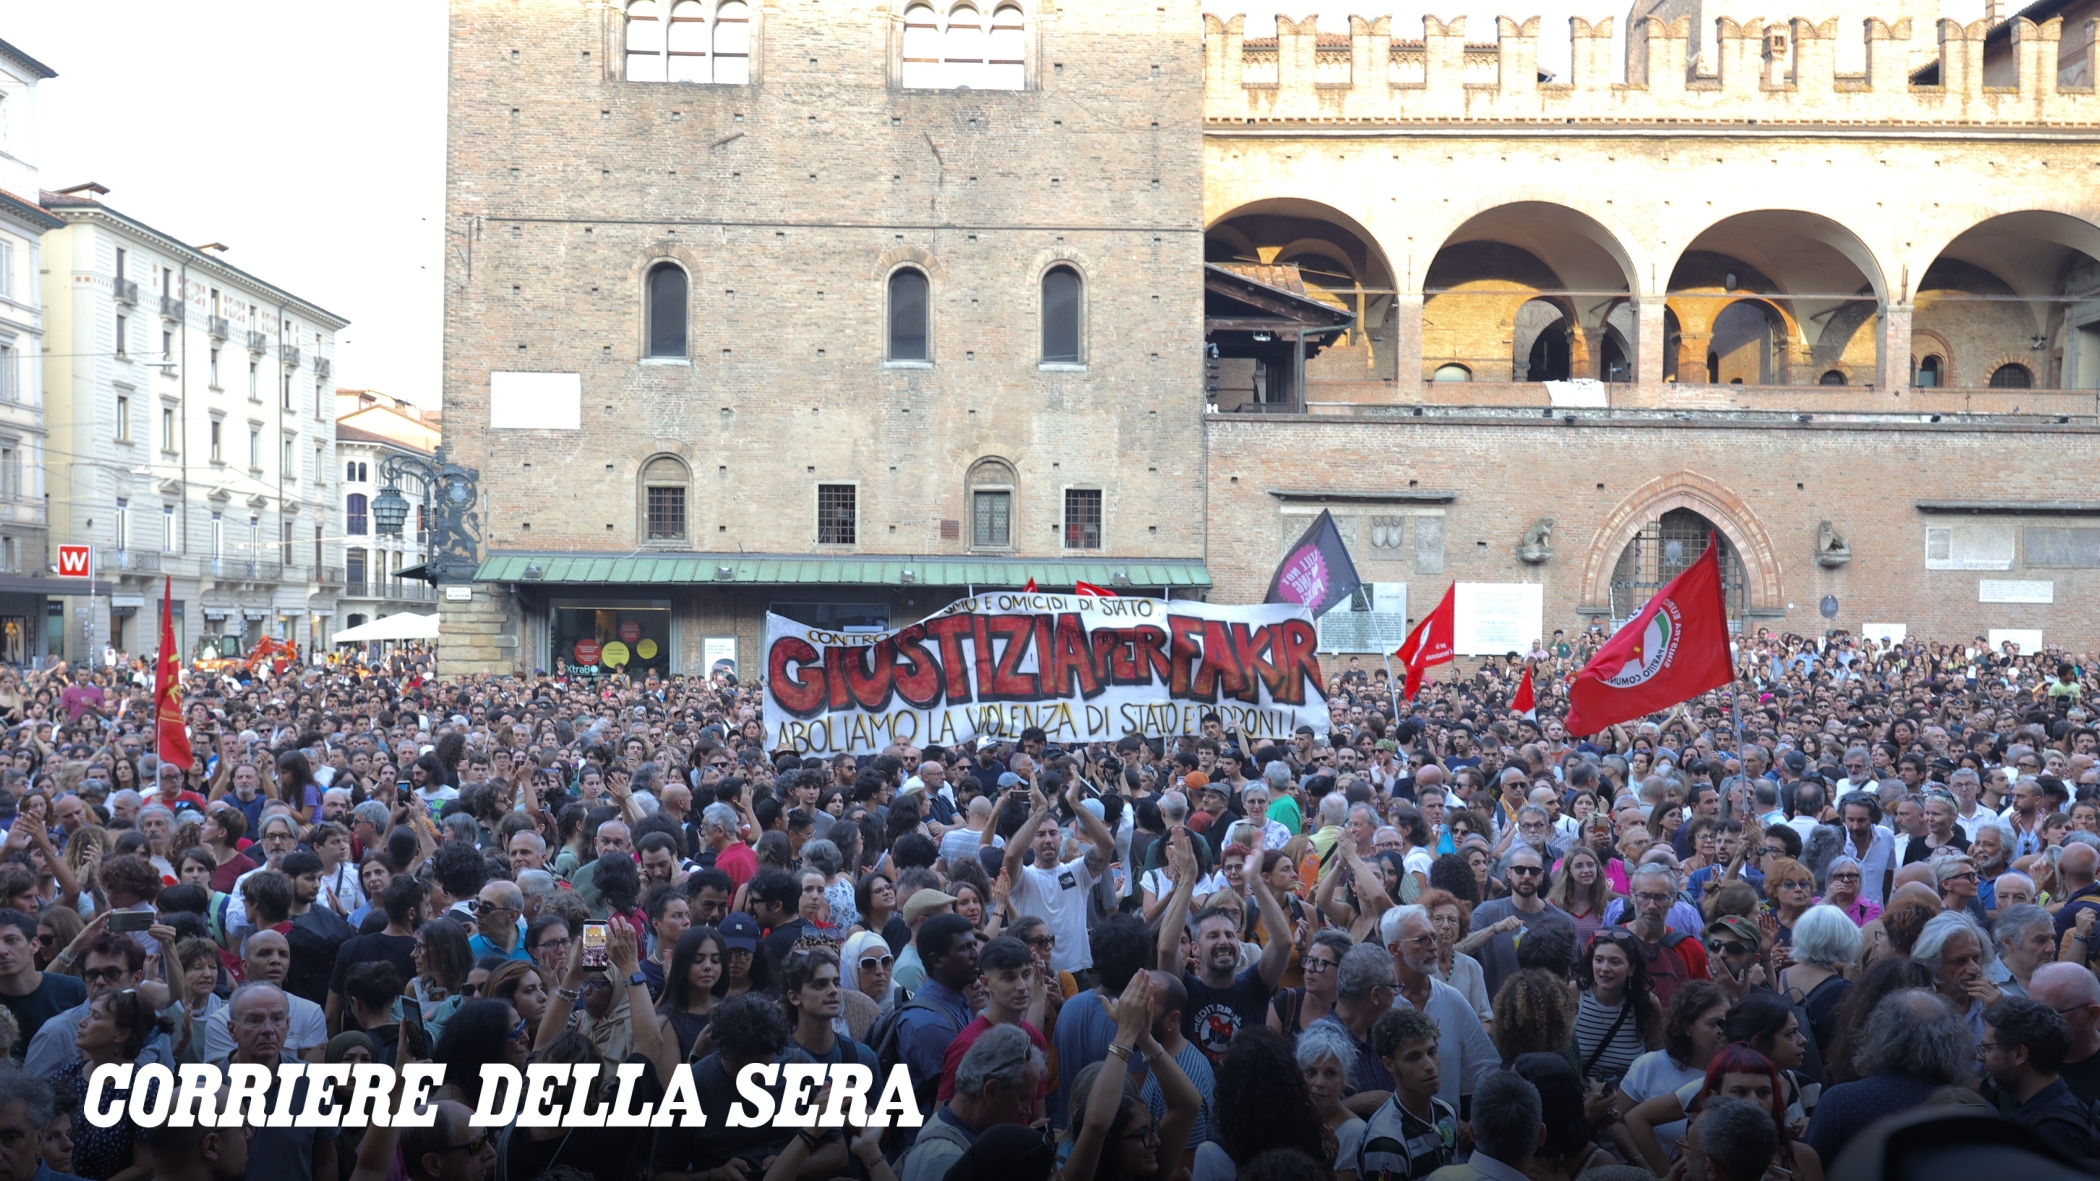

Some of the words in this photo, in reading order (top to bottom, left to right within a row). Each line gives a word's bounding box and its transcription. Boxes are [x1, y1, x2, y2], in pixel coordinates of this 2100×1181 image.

[61, 551, 87, 572] W
[985, 595, 992, 611] E
[999, 595, 1068, 611] OMICIDI
[1078, 598, 1094, 611] DI
[1100, 597, 1153, 617] STATO
[808, 630, 890, 645] CONTRO
[768, 612, 1106, 719] GIUSTIZIA
[1091, 624, 1171, 686] PER
[1168, 613, 1327, 706] FAKIR
[777, 710, 918, 752] ABOLIAMO
[928, 709, 960, 744] LA
[967, 702, 1077, 739] VIOLENZA
[1086, 705, 1109, 736] DI
[1121, 703, 1178, 734] STATO
[1183, 706, 1194, 736] E
